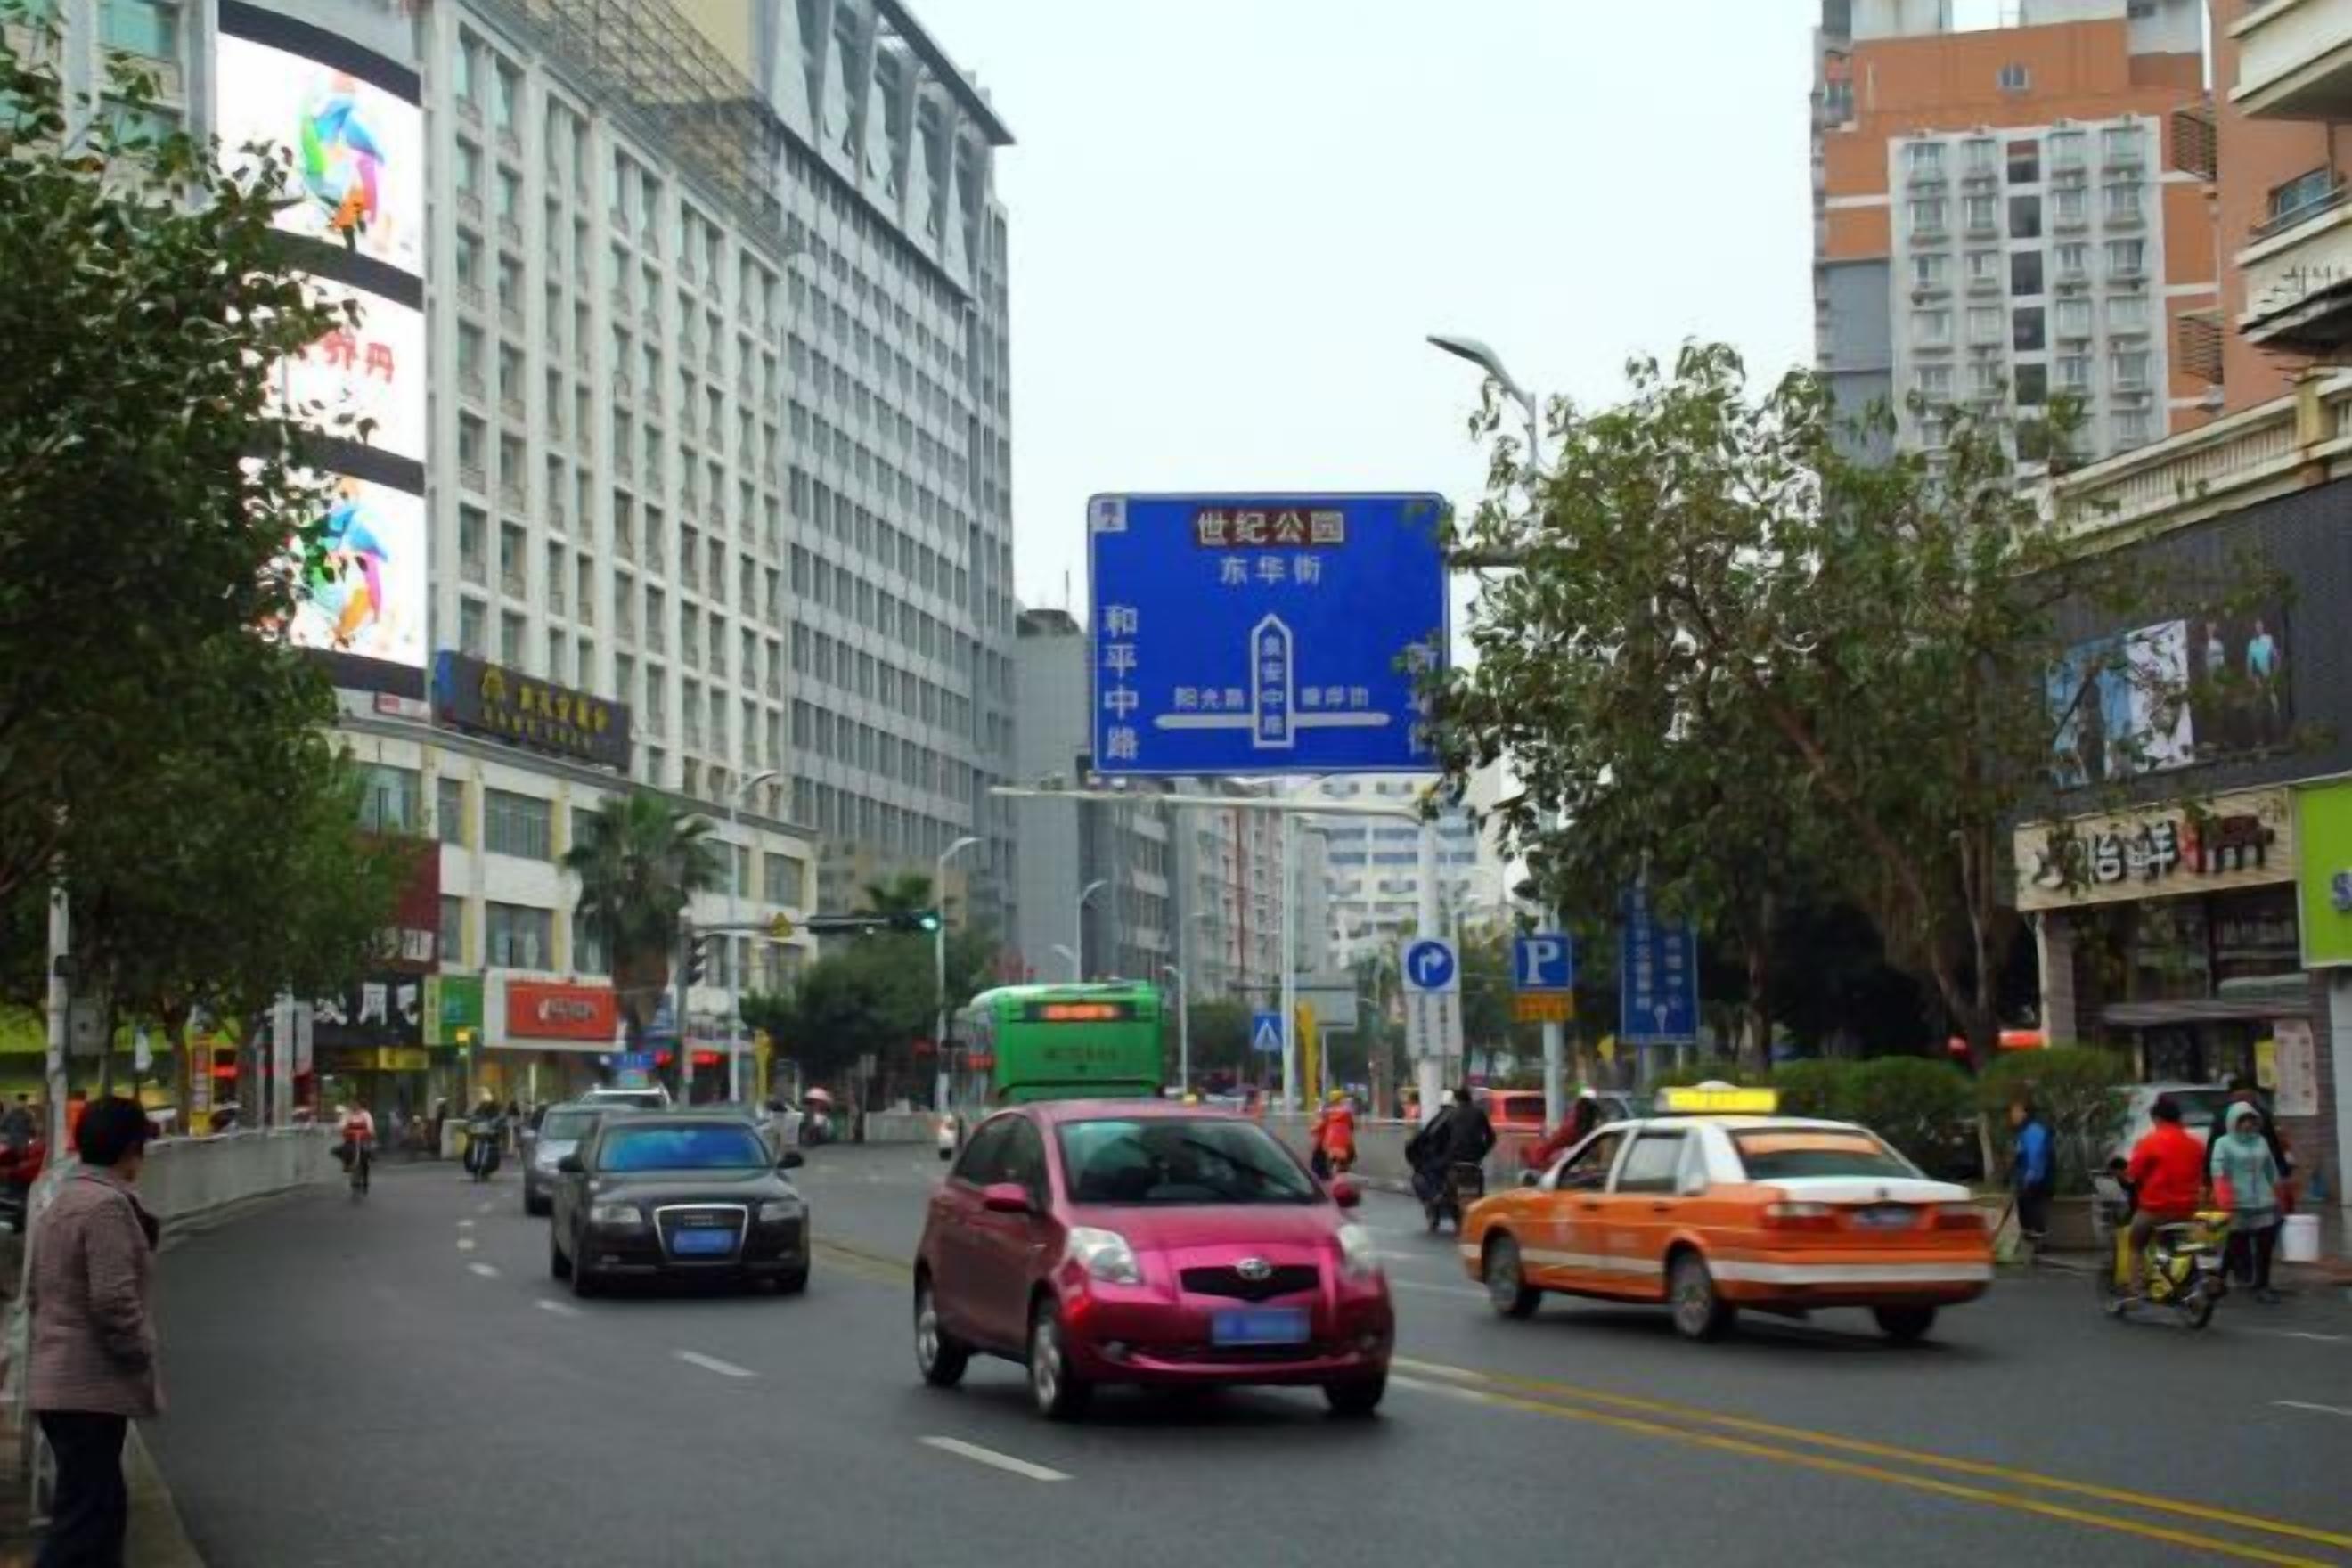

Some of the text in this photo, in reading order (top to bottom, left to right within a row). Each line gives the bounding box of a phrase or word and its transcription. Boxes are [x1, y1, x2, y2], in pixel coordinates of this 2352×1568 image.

[1198, 510, 1344, 545] 世纪公园
[1221, 555, 1321, 585] 东华街
[1105, 605, 1139, 760] 和平中路
[1524, 940, 1560, 984] P
